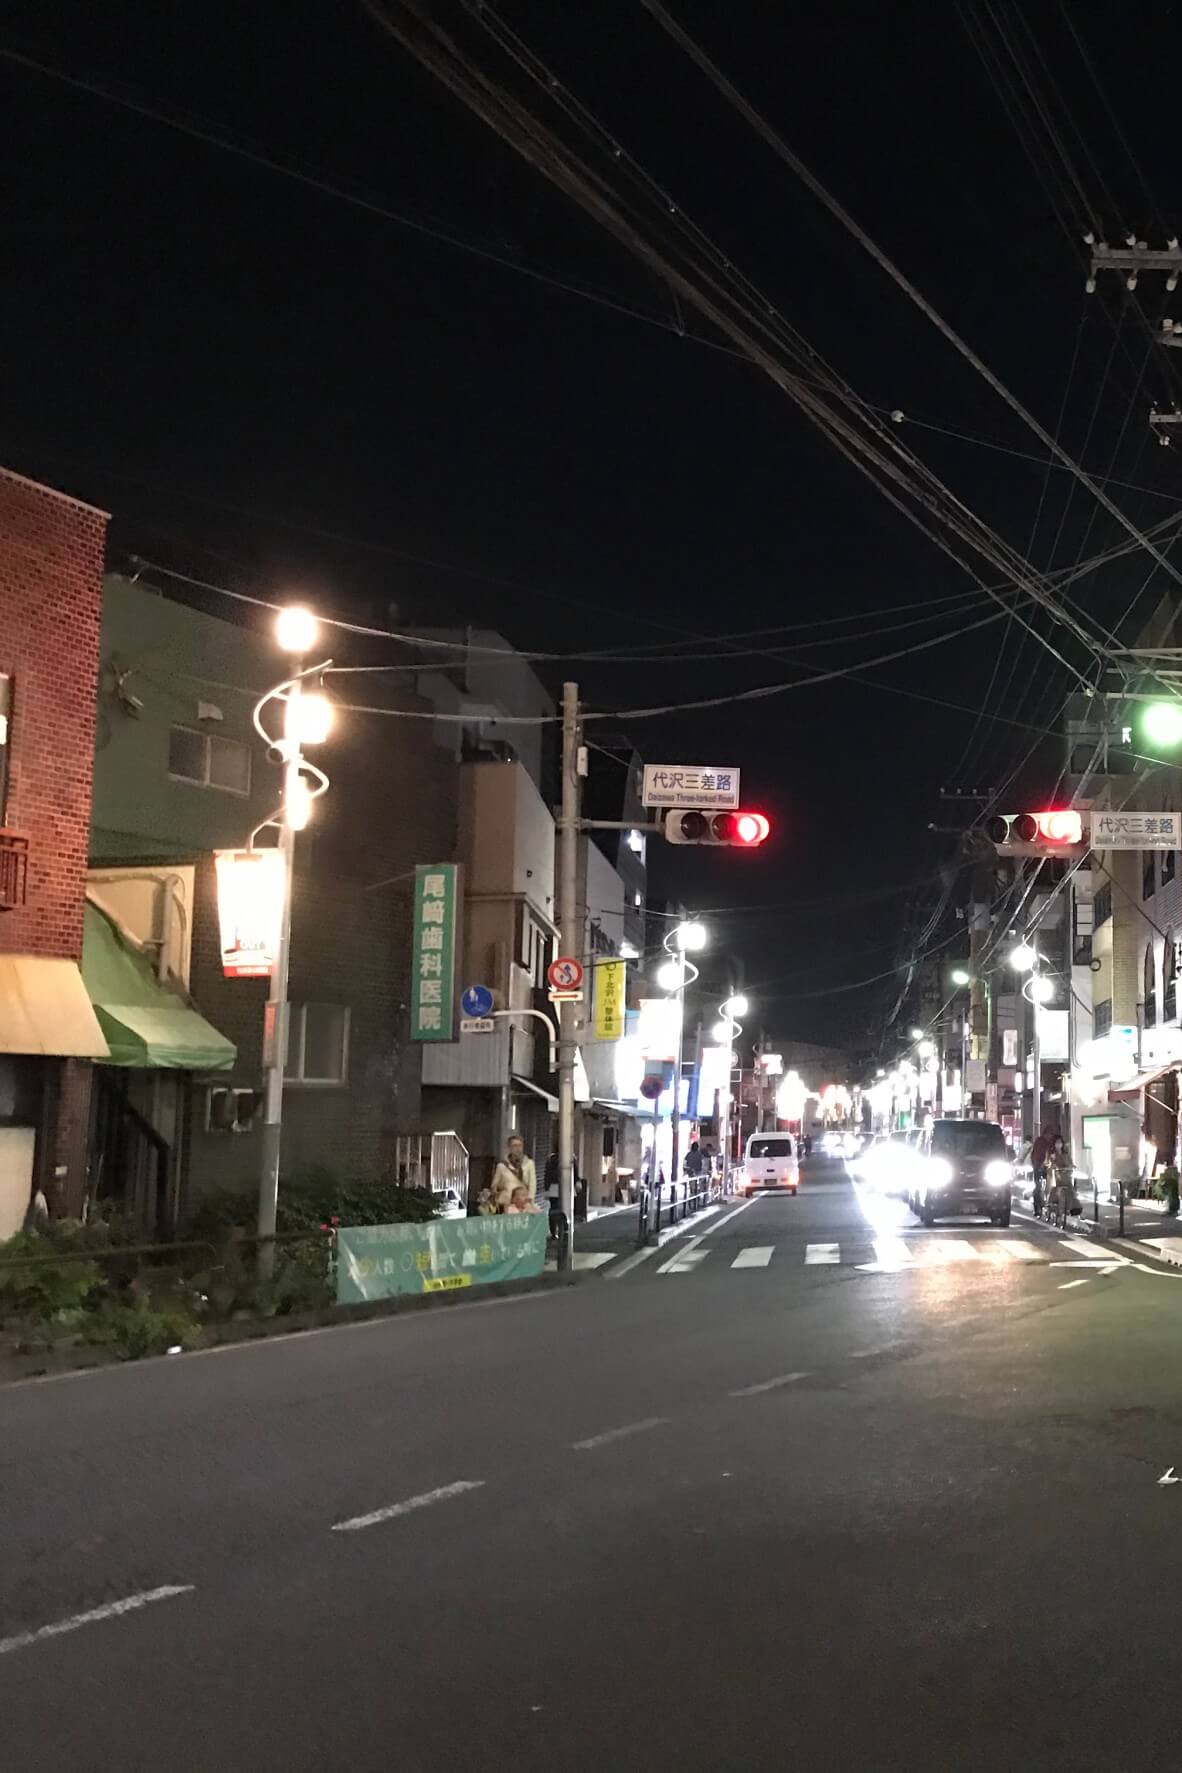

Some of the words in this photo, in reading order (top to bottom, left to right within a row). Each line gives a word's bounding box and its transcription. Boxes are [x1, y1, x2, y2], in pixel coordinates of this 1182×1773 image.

[652, 771, 731, 791] 代沢三差路
[1098, 816, 1174, 834] 代沢三差路
